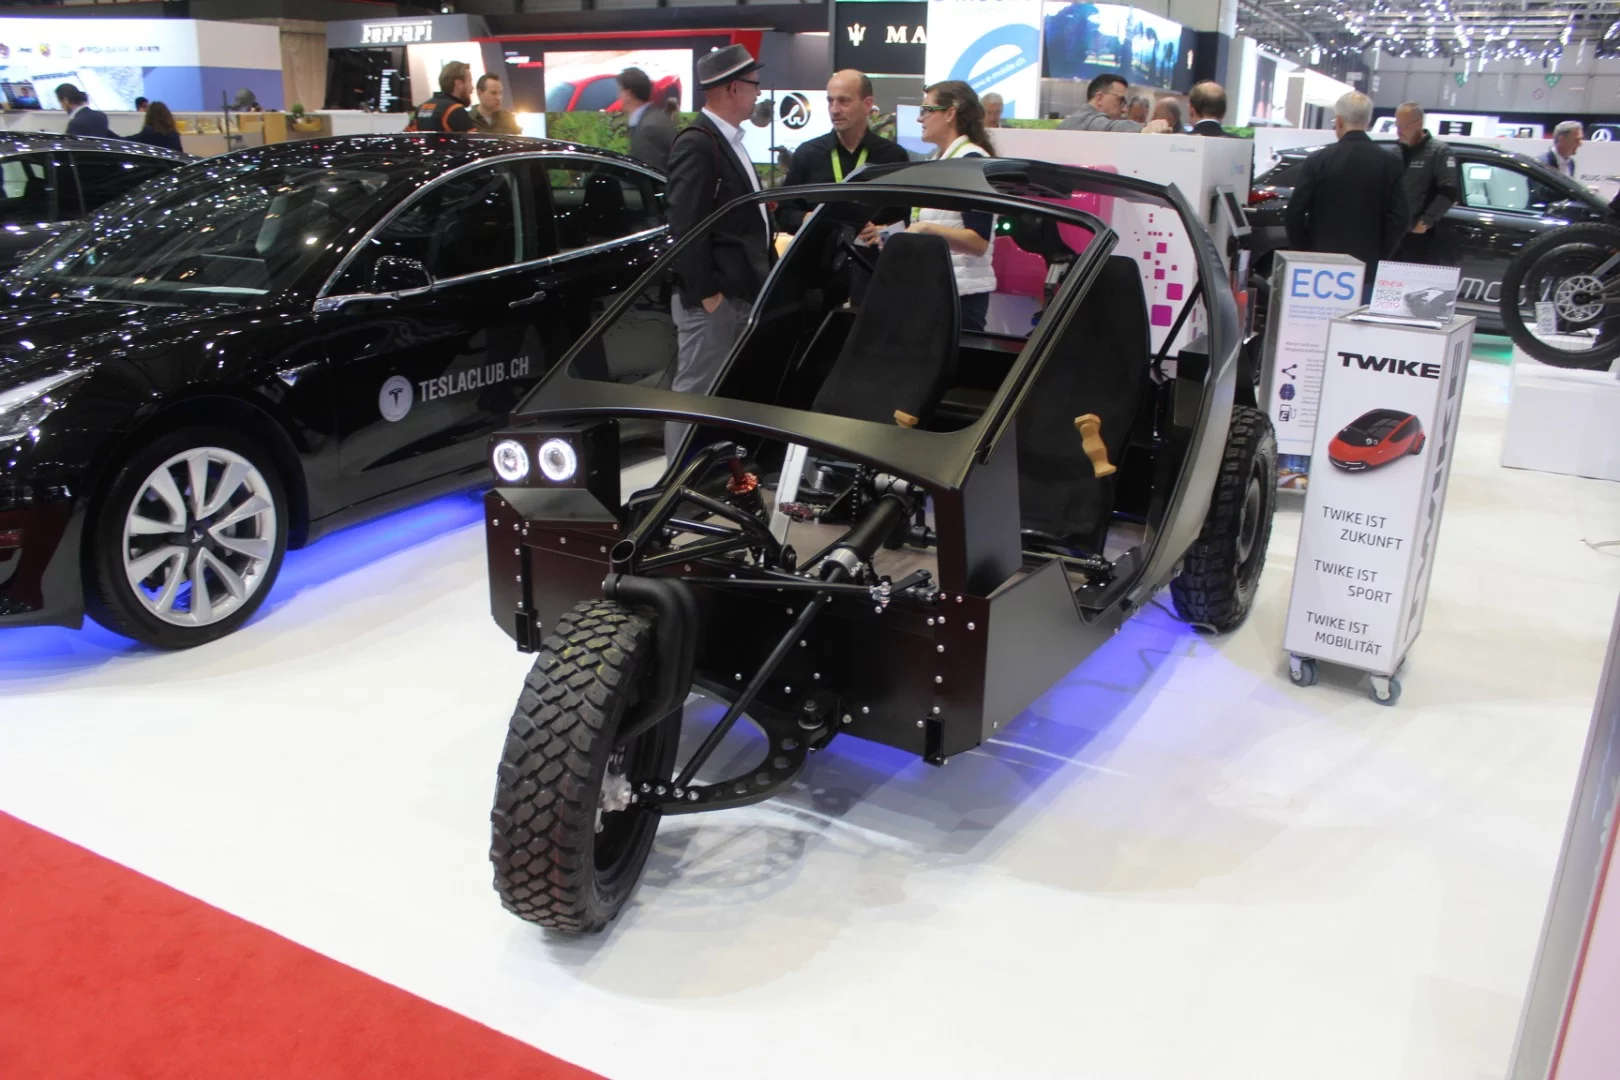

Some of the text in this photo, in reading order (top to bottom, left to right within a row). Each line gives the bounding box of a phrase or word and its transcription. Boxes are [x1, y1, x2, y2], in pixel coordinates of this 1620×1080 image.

[360, 20, 432, 43] Ferrari
[1290, 268, 1356, 300] ECS
[1374, 301, 1400, 309] 2019
[1337, 351, 1441, 380] TWIKE
[418, 356, 529, 402] TESLACLUB.CH
[1322, 505, 1387, 529] TWIKE IST
[1340, 528, 1403, 551] ZUKUNFT
[1314, 559, 1378, 583] TWIKE IST
[1347, 585, 1392, 604] SPORT
[1306, 611, 1369, 635] TWIKE IST
[1314, 631, 1382, 656] MOBILITÄT
